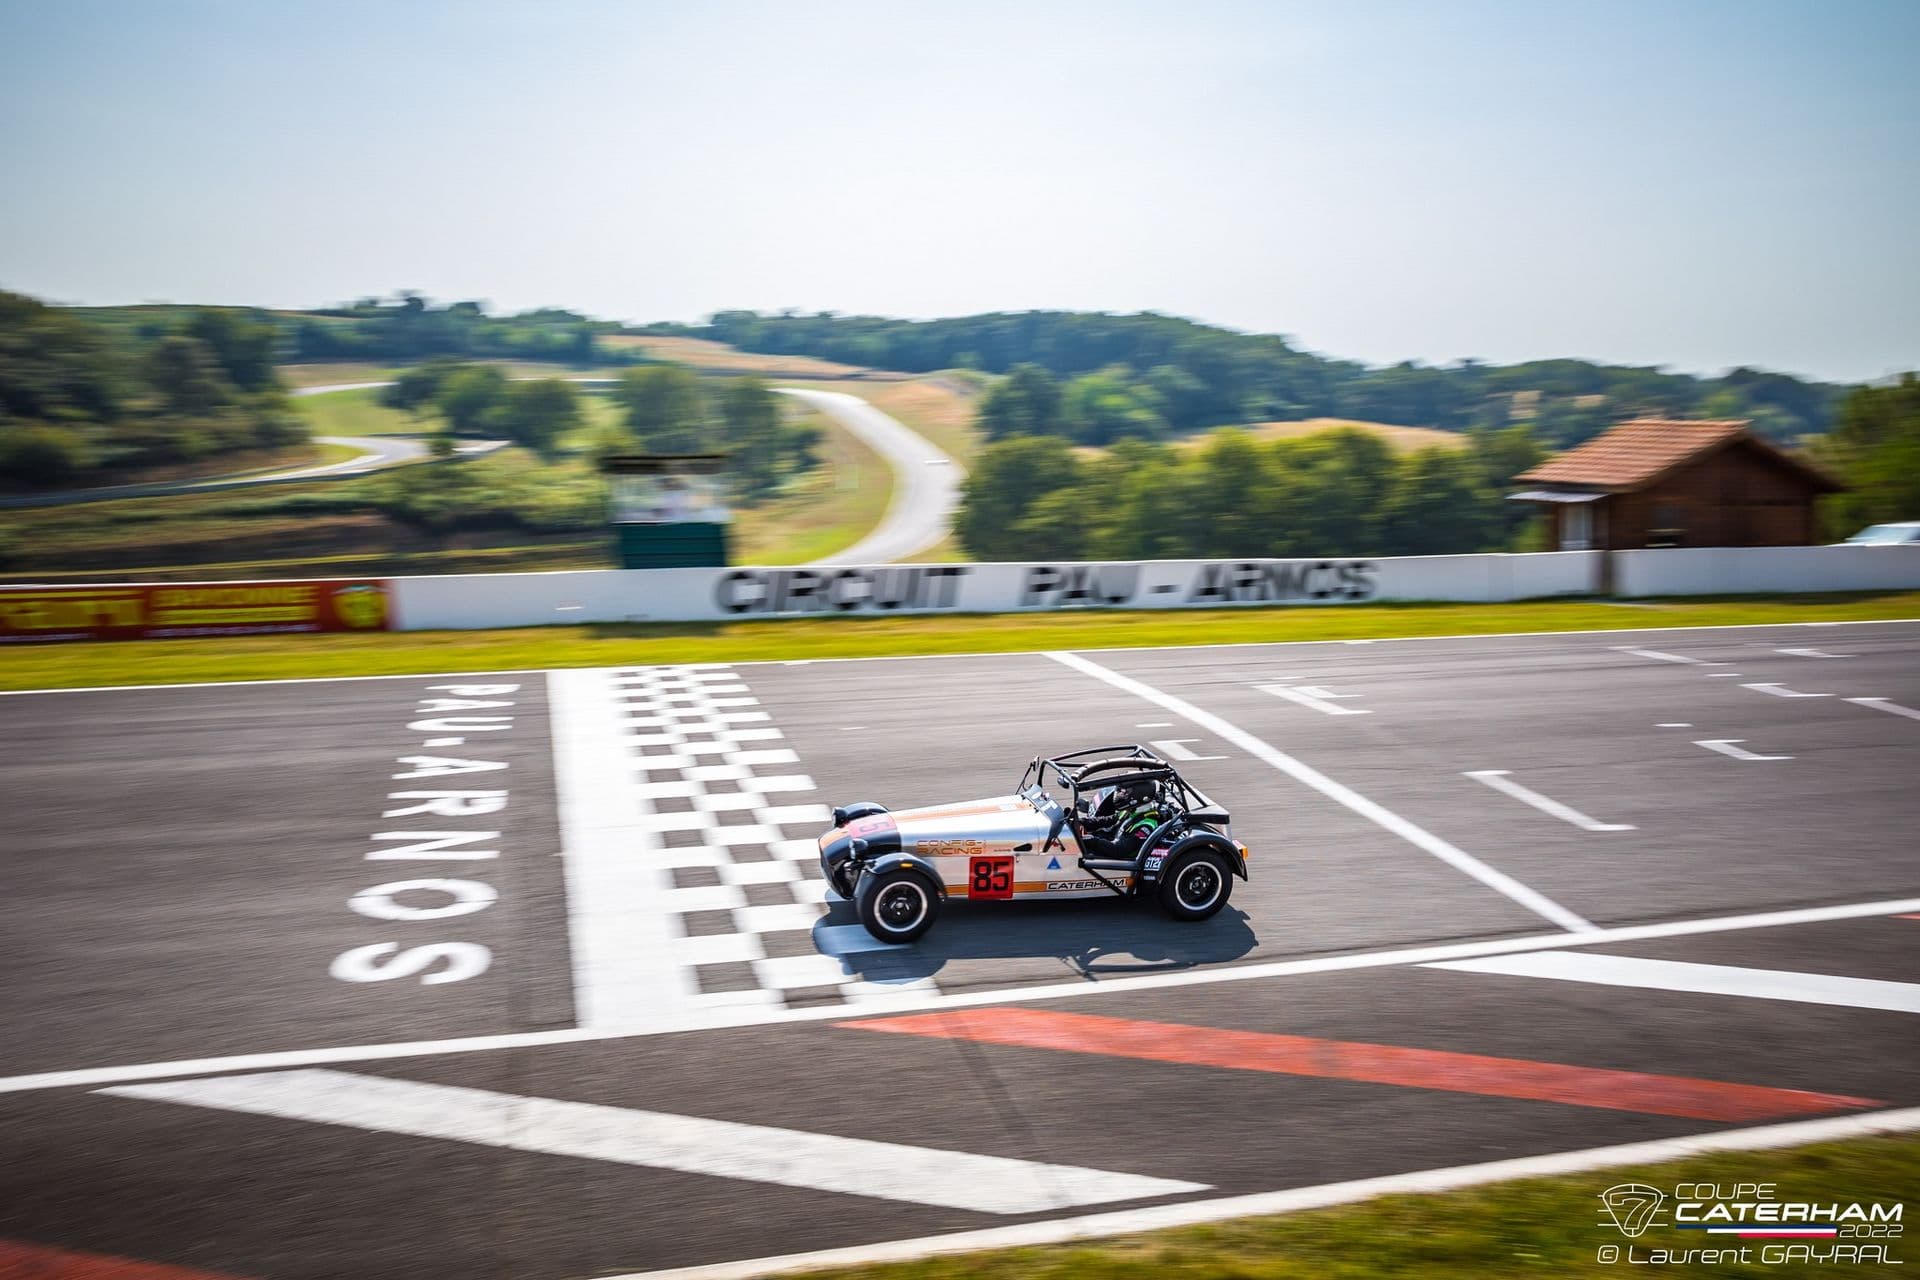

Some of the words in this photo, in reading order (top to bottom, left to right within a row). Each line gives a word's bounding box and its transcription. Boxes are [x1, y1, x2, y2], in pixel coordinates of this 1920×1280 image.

[716, 567, 972, 613] CIRCUIT
[918, 847, 982, 855] RACING
[974, 861, 1010, 892] 85
[1047, 879, 1125, 890] CATERHM
